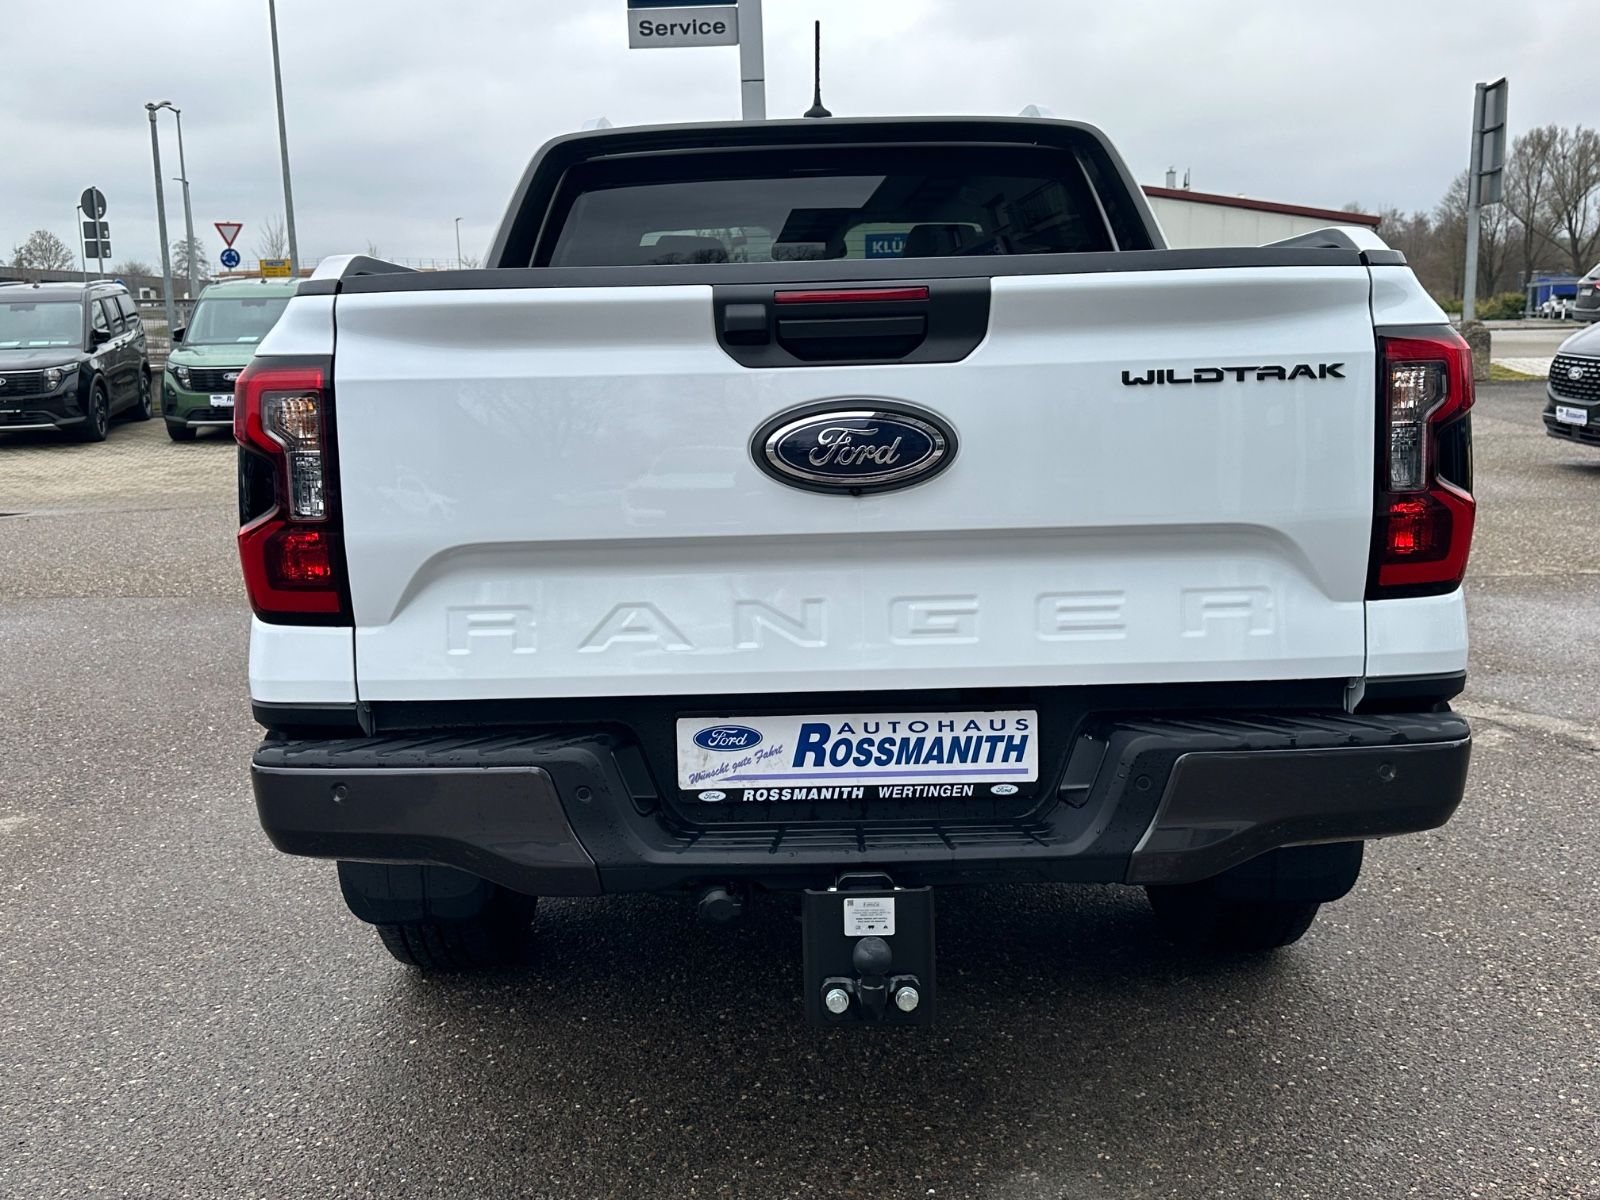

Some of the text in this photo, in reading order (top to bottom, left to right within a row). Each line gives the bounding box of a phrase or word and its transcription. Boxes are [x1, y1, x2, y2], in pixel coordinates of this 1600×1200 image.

[639, 19, 727, 37] Service
[872, 237, 906, 254] KLÜ
[1121, 362, 1346, 386] WILDTRAK
[809, 427, 902, 466] Ford
[446, 585, 1276, 654] RANGER
[837, 718, 1030, 735] AUTOHAUS
[707, 728, 748, 748] Ford
[792, 723, 1029, 768] ROSSMANITH
[688, 743, 784, 785] Wünscht gute Fahrt
[742, 784, 975, 802] ROSSMANITH WERTINGEN
